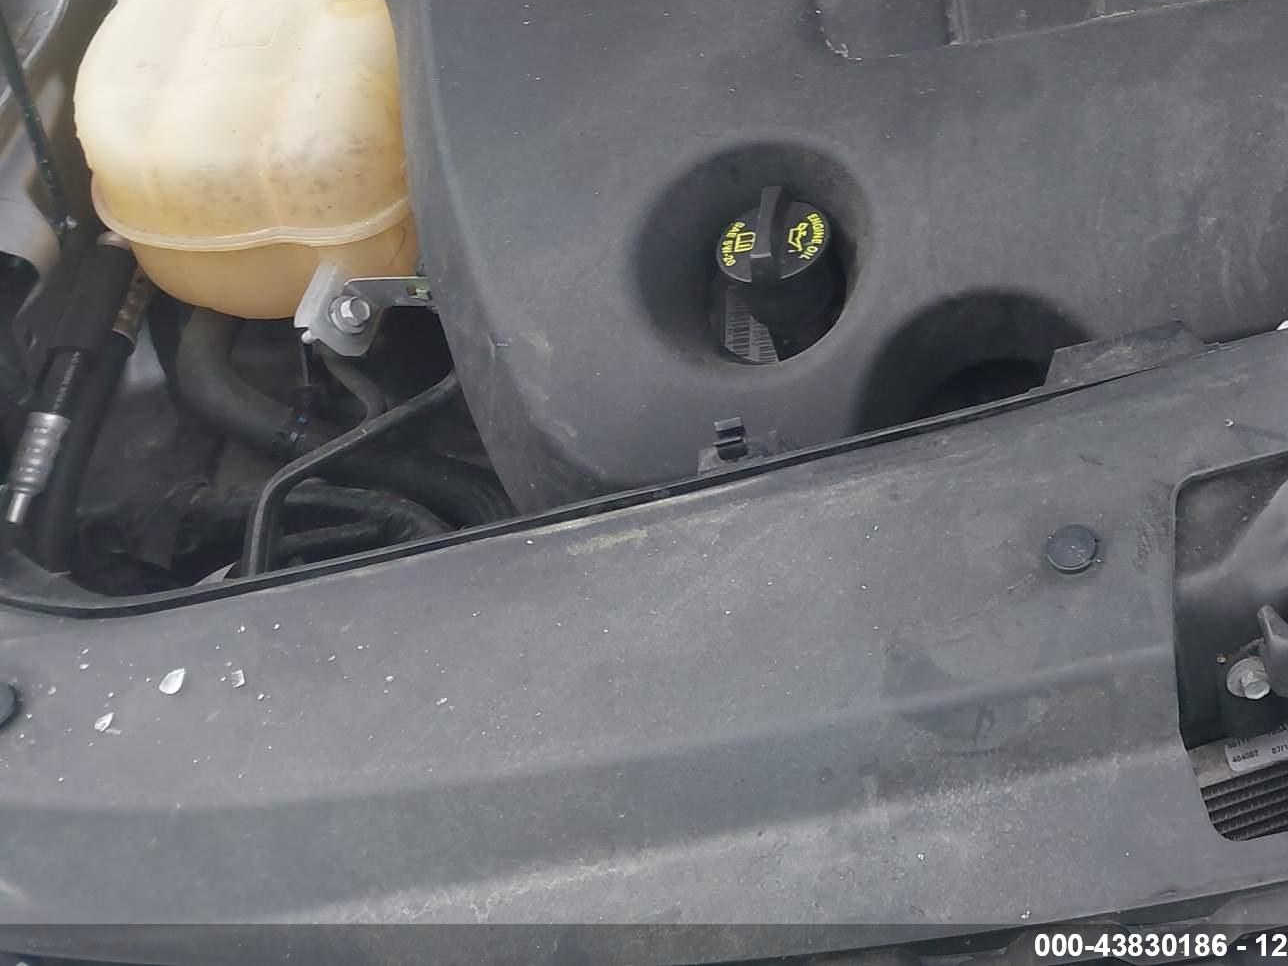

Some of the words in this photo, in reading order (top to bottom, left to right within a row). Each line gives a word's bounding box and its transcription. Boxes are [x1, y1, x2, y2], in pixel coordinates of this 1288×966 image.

[726, 221, 746, 238] SAE
[807, 213, 825, 245] ENGINE
[721, 239, 736, 267] 5W-20
[798, 245, 818, 260] OIL
